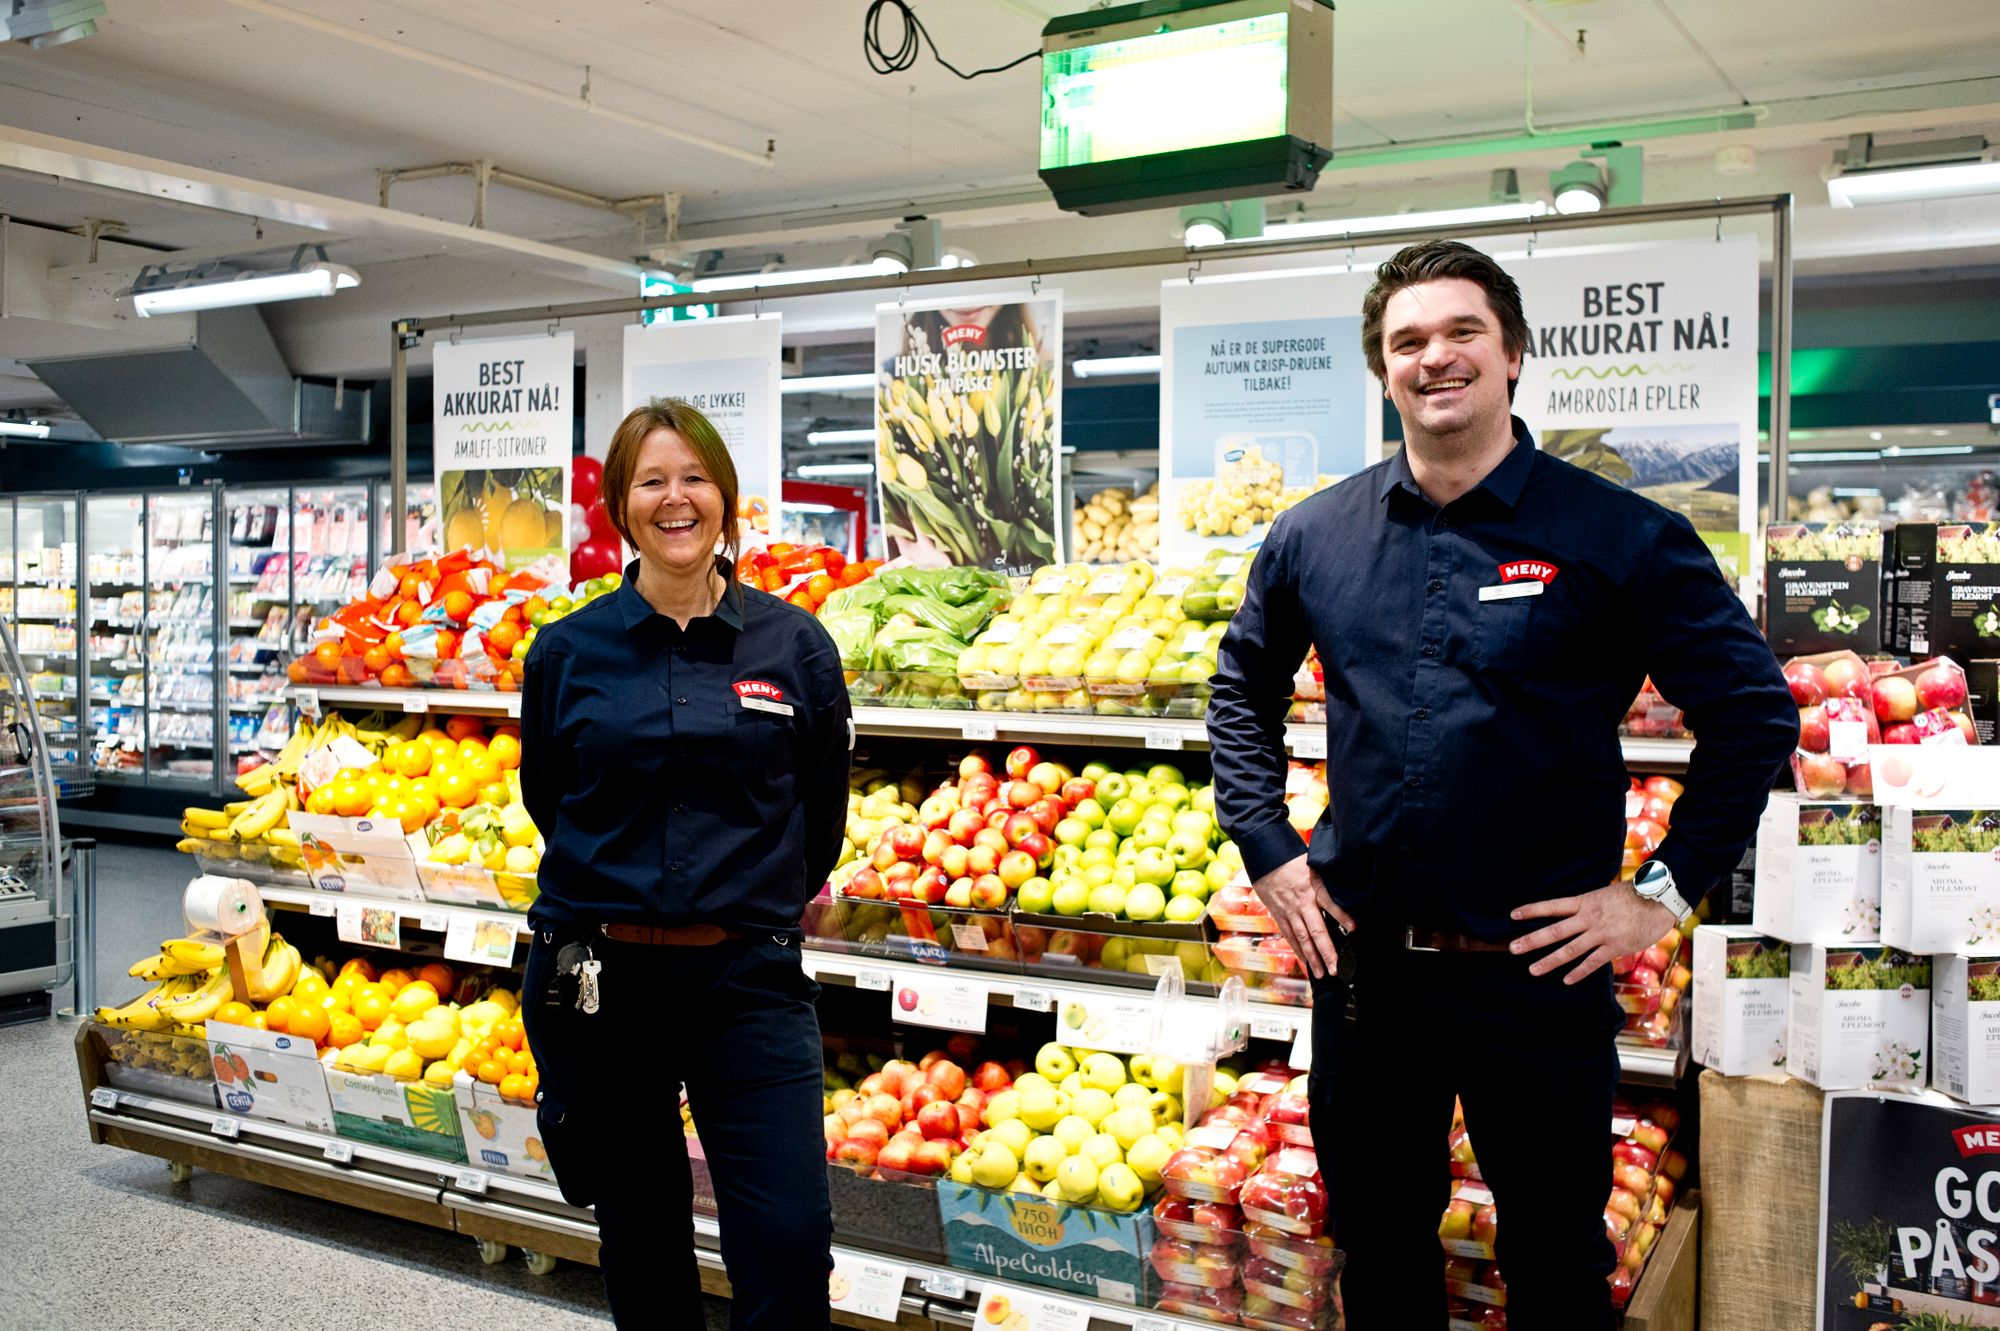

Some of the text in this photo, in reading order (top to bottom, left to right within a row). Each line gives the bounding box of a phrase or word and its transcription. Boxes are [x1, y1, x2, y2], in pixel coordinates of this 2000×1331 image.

[1583, 282, 1665, 318] BEST
[947, 327, 984, 342] MENY
[1523, 312, 1729, 358] AKKURAT NÅ!
[1211, 337, 1326, 357] NÅ ER DE SUPERGODE
[895, 347, 1037, 377] HUSK BLOMSTER
[1204, 355, 1332, 376] AUTUMN CRISP-DRUENE
[479, 361, 525, 386] BEST
[1243, 375, 1291, 391] TILBAKE!
[933, 378, 951, 394] TIL
[443, 383, 560, 417] AKKURAT NÅ!
[693, 394, 705, 409] OG
[709, 392, 745, 408] LYKKE!
[1547, 383, 1700, 415] AMBROSIA EPLER
[454, 436, 547, 459] AMALFI-SITRONER
[1505, 564, 1552, 578] MENY
[1785, 581, 1849, 590] GRAVENSTEIN
[1951, 593, 1994, 601] EPLEMOST
[739, 683, 779, 696] MENY
[911, 945, 945, 959] KANZI
[343, 1078, 399, 1097] Costieragrumi
[228, 1096, 251, 1107] CEVITA
[1963, 1131, 2000, 1149] ME
[483, 1152, 506, 1164] CEVITA
[1935, 1167, 2000, 1223] GO
[1021, 1208, 1049, 1224] 750
[1018, 1221, 1058, 1241] MOH
[1897, 1218, 2000, 1282] PÅS
[973, 1242, 1100, 1285] AlpeGolden
